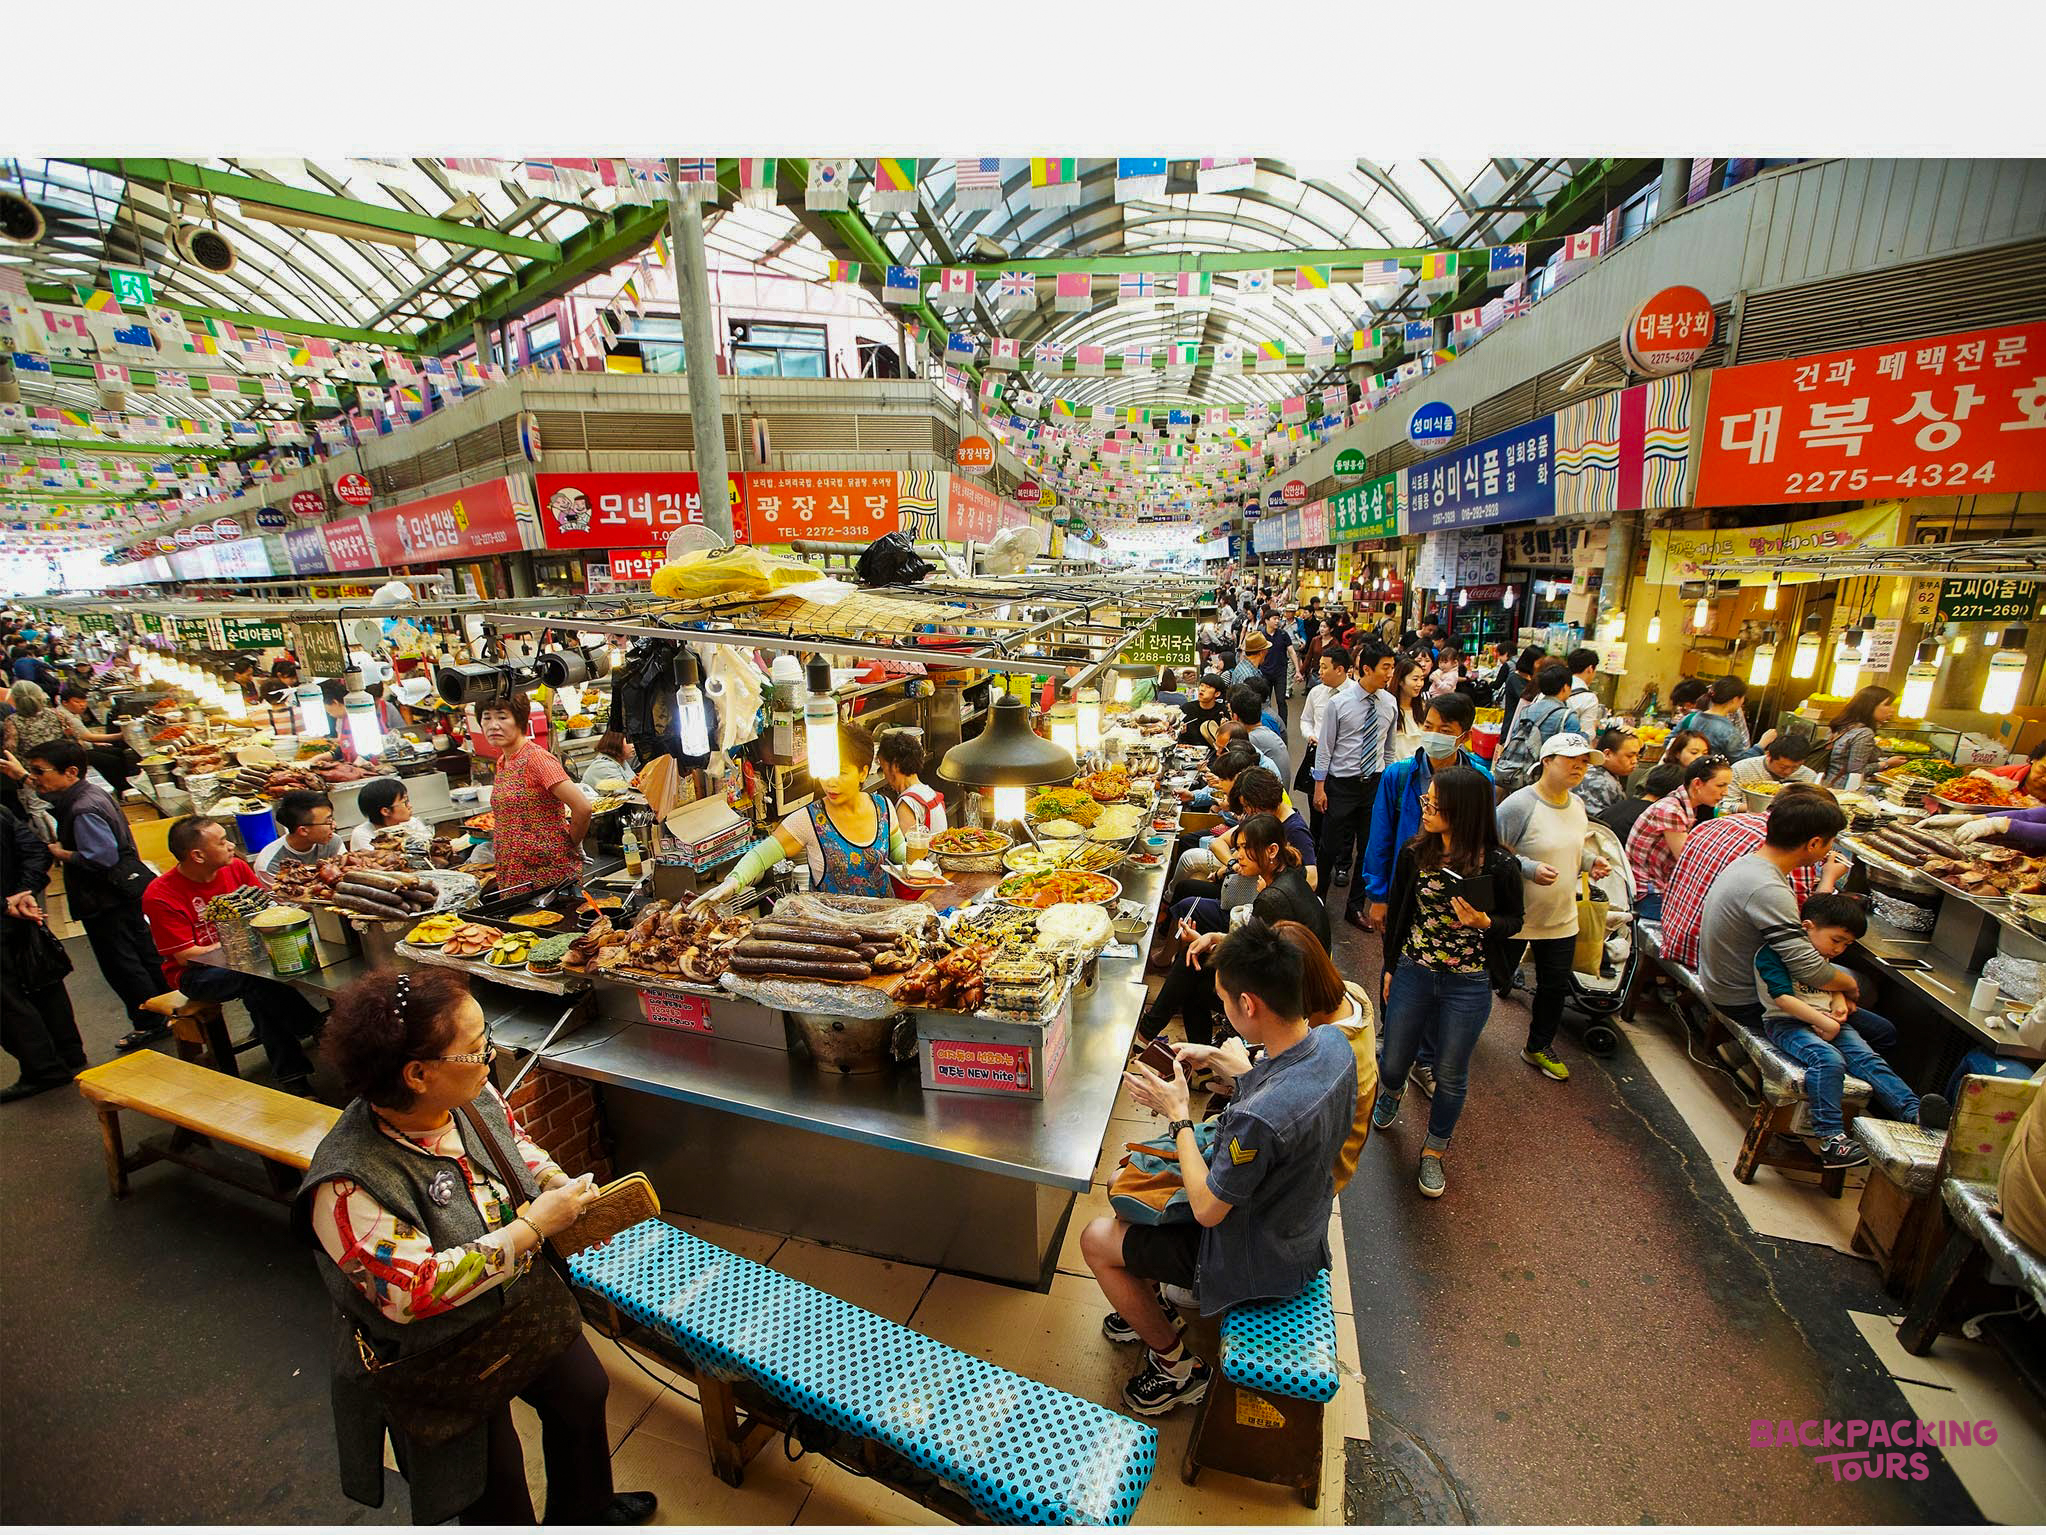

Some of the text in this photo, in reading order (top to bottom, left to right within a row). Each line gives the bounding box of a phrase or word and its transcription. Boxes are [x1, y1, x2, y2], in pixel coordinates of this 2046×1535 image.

[1640, 311, 1709, 340] 대복상회
[1651, 351, 1695, 364] 2275-4324
[1793, 358, 1856, 392] 건과
[1413, 415, 1454, 434] 성미식품
[958, 448, 990, 461] 광장식당
[1506, 434, 1548, 467] 일회용품
[1336, 459, 1365, 471] 동명홍삼
[1432, 448, 1500, 507] 성미식품
[1784, 460, 1996, 494] 2275-4324
[1337, 483, 1383, 528] 동명홍삼
[410, 507, 459, 548] 모녀김밥
[806, 525, 869, 537] 2272-3318
[1918, 592, 1935, 603] 62
[1945, 578, 2036, 599] 고씨아줌마
[227, 626, 283, 643] 순대아줌마
[1149, 634, 1193, 651] 잔치국수
[1133, 652, 1191, 663] 2268-6738
[938, 1065, 1014, 1082] 맥주는 NEW hite
